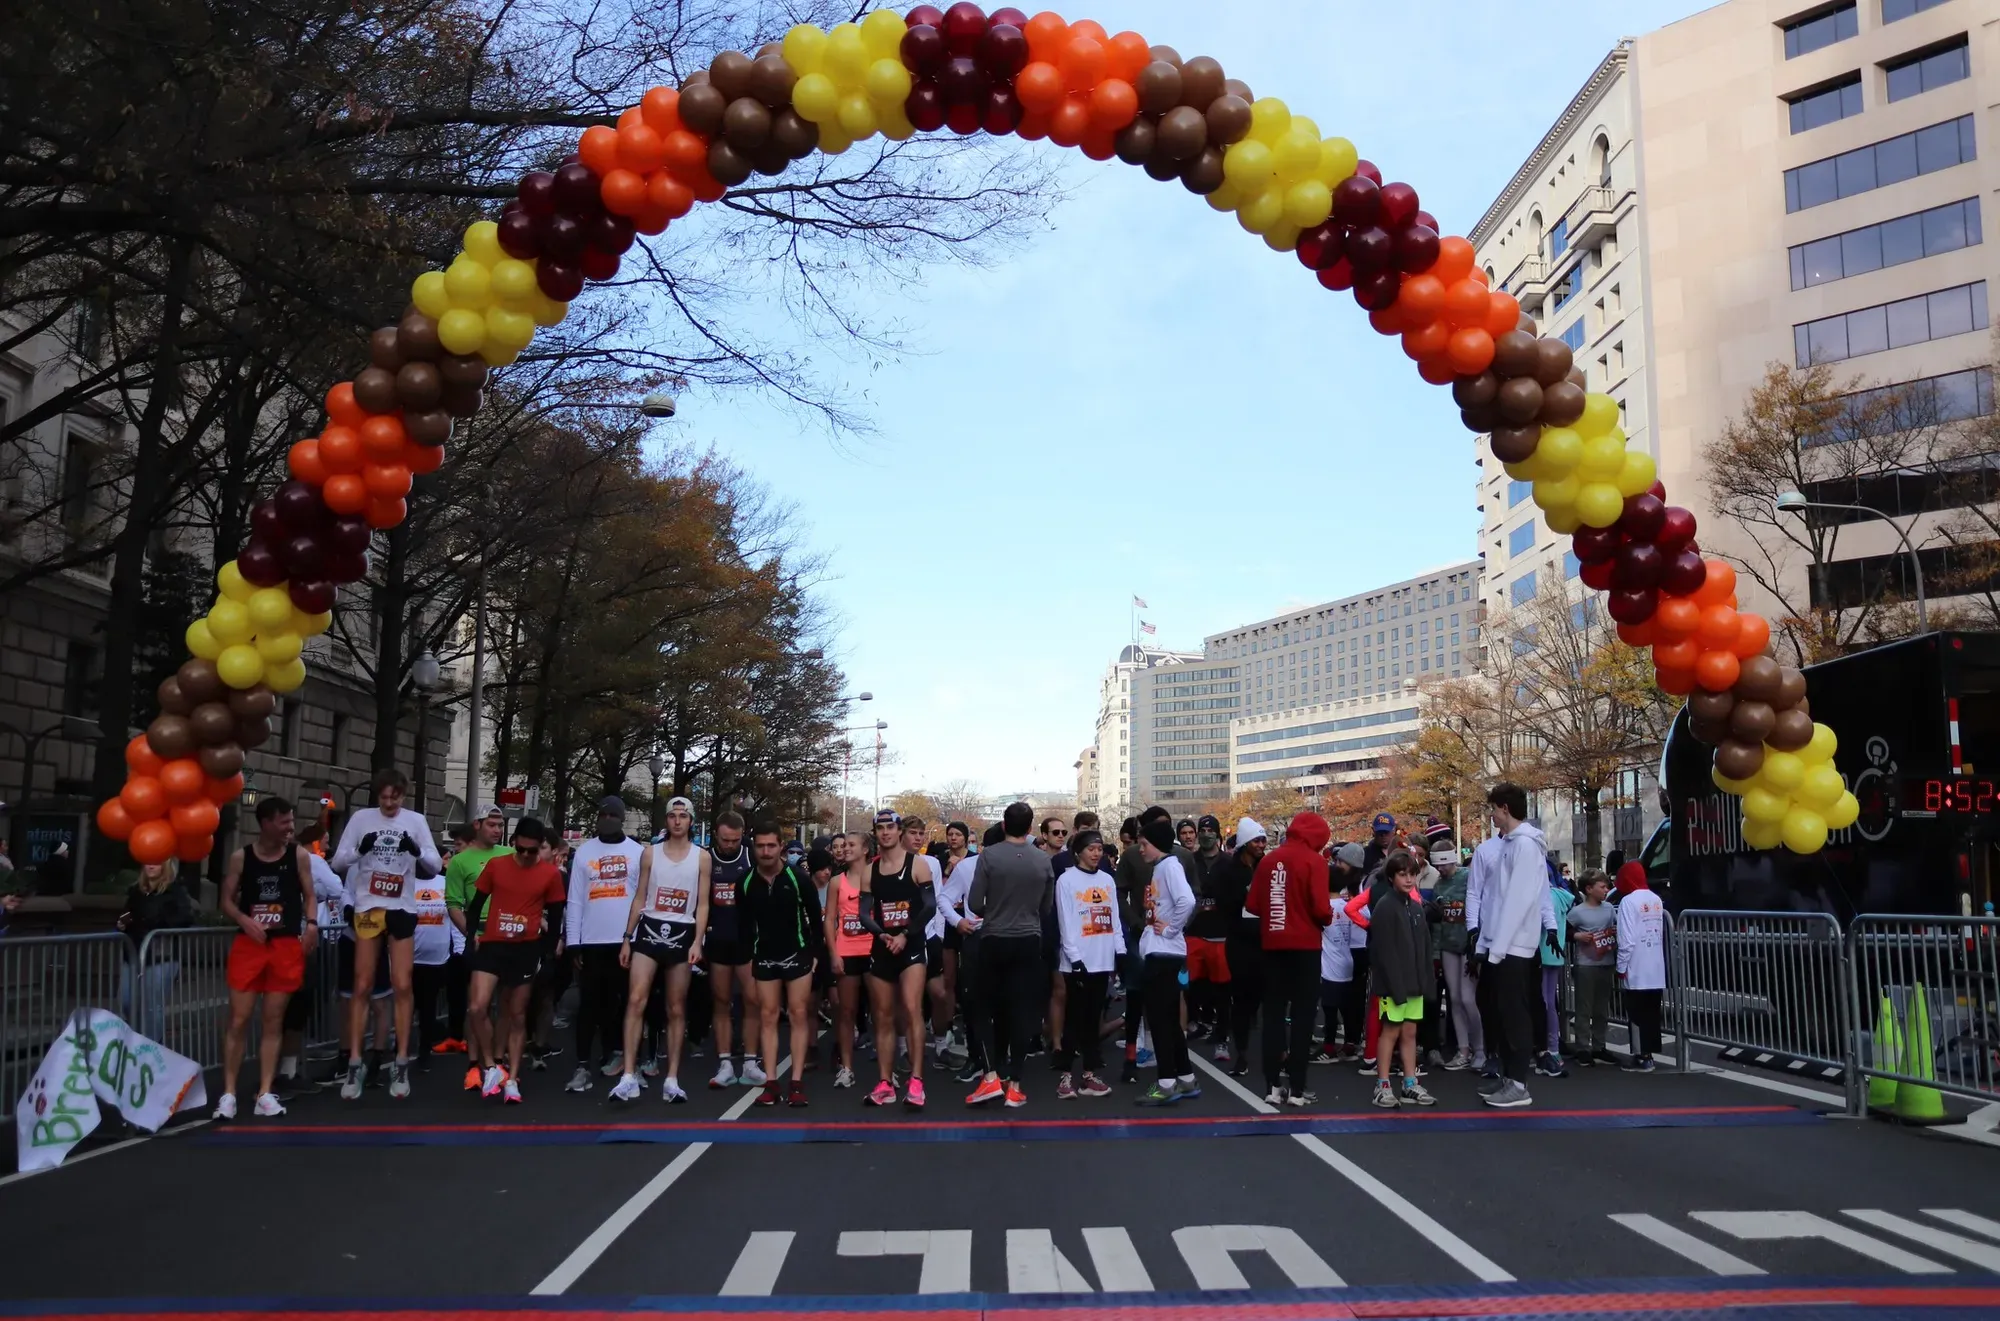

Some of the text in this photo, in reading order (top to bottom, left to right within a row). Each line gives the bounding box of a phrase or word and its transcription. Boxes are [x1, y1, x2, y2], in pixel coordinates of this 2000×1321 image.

[600, 863, 626, 873] 4082
[375, 880, 399, 892] 6101
[658, 896, 686, 908] 5207
[1268, 883, 1286, 932] MONTOYA
[253, 913, 281, 923] 4770
[883, 910, 909, 921] 3756
[499, 922, 525, 933] 3619
